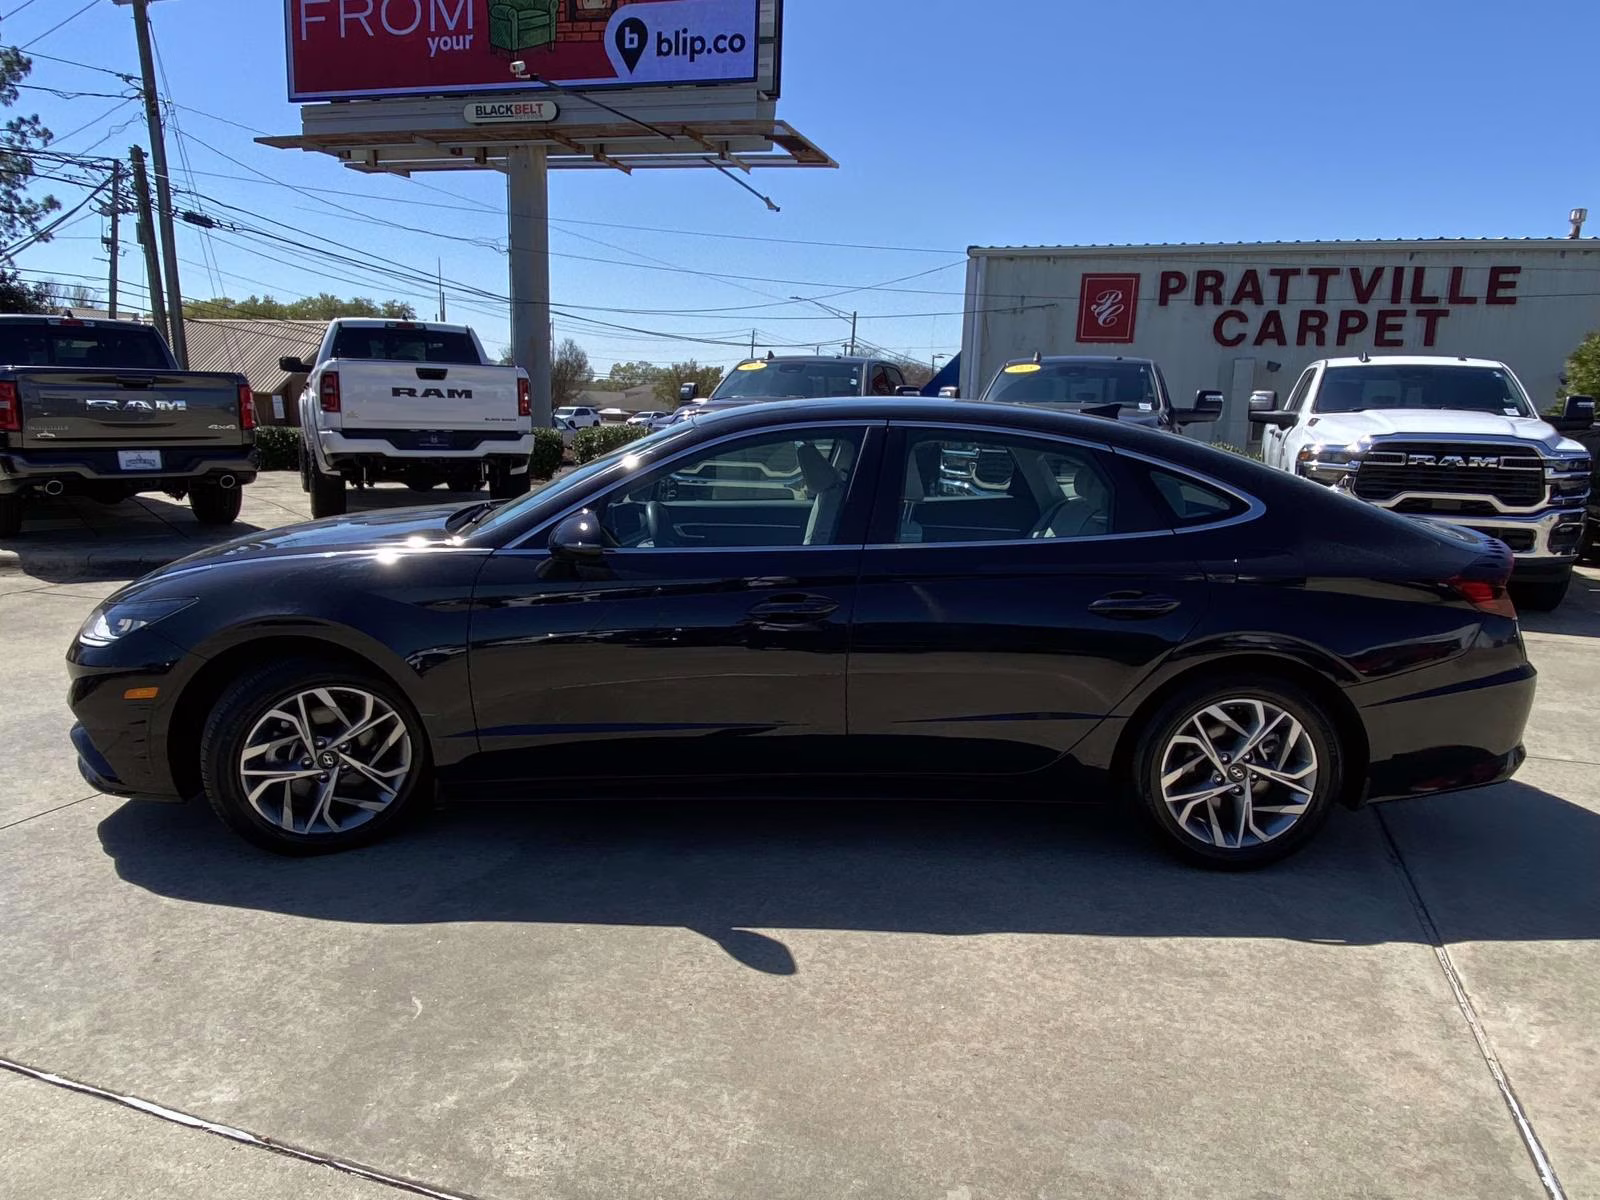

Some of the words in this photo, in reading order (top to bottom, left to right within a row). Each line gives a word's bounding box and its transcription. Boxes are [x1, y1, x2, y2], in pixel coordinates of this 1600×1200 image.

[301, 0, 472, 40] FROM
[427, 34, 473, 57] your
[656, 28, 746, 62] blip.co
[1159, 266, 1521, 306] PRATTVILLE
[1213, 309, 1450, 347] CARPET
[86, 400, 187, 411] RAM
[392, 387, 473, 399] RAM
[1406, 454, 1499, 467] RAM
